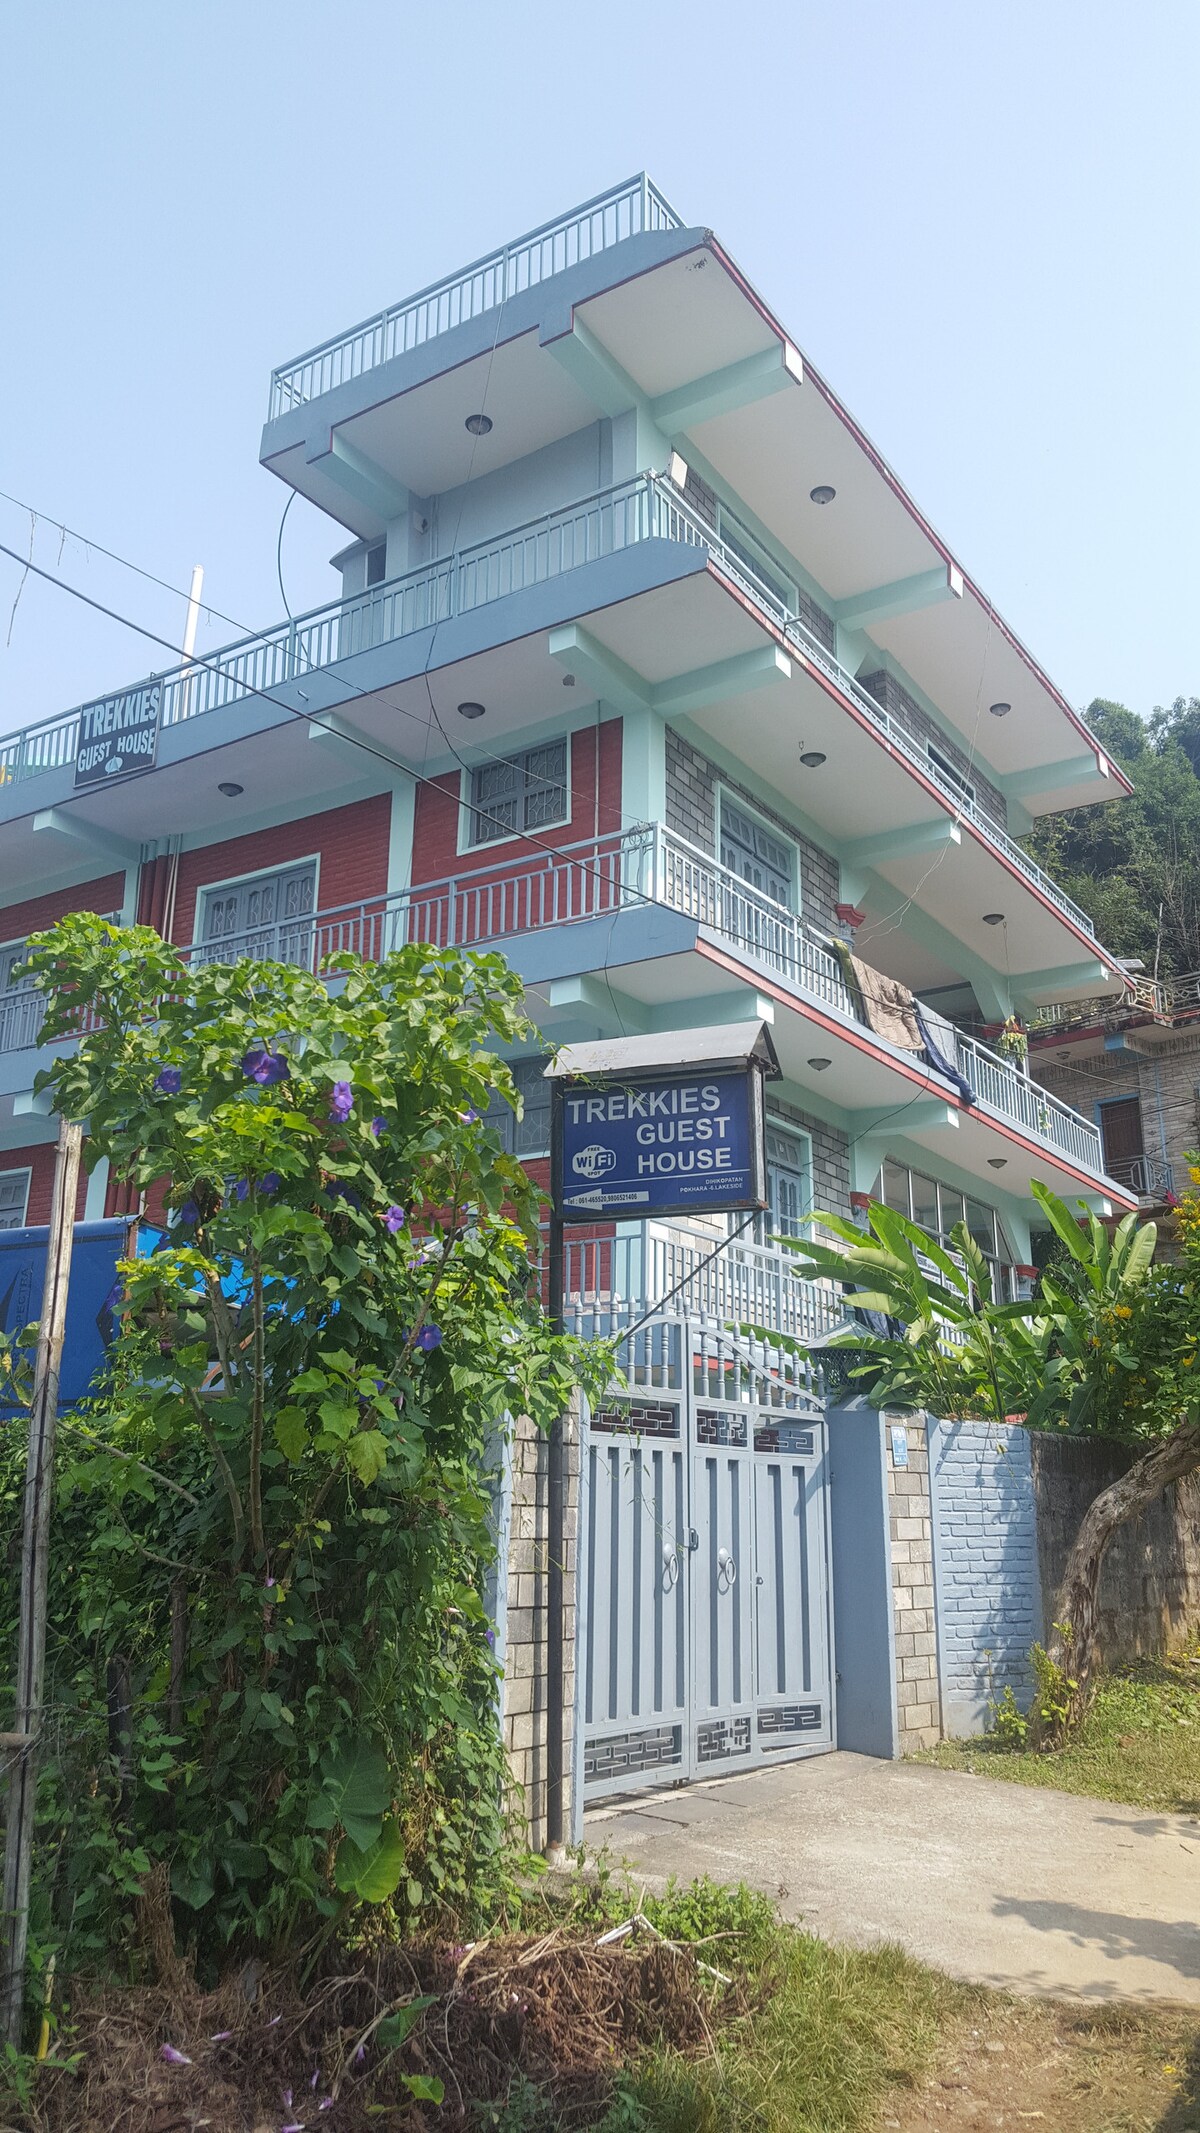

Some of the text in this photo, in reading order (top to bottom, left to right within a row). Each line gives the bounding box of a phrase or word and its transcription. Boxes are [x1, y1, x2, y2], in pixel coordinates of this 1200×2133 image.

[82, 687, 159, 740] TREKKIES
[77, 727, 155, 772] GUEST HOUSE
[567, 1085, 721, 1125] TREKKIES
[635, 1116, 731, 1145] GUEST
[638, 1147, 732, 1174] HOUSE
[679, 1185, 707, 1193] POKHARA
